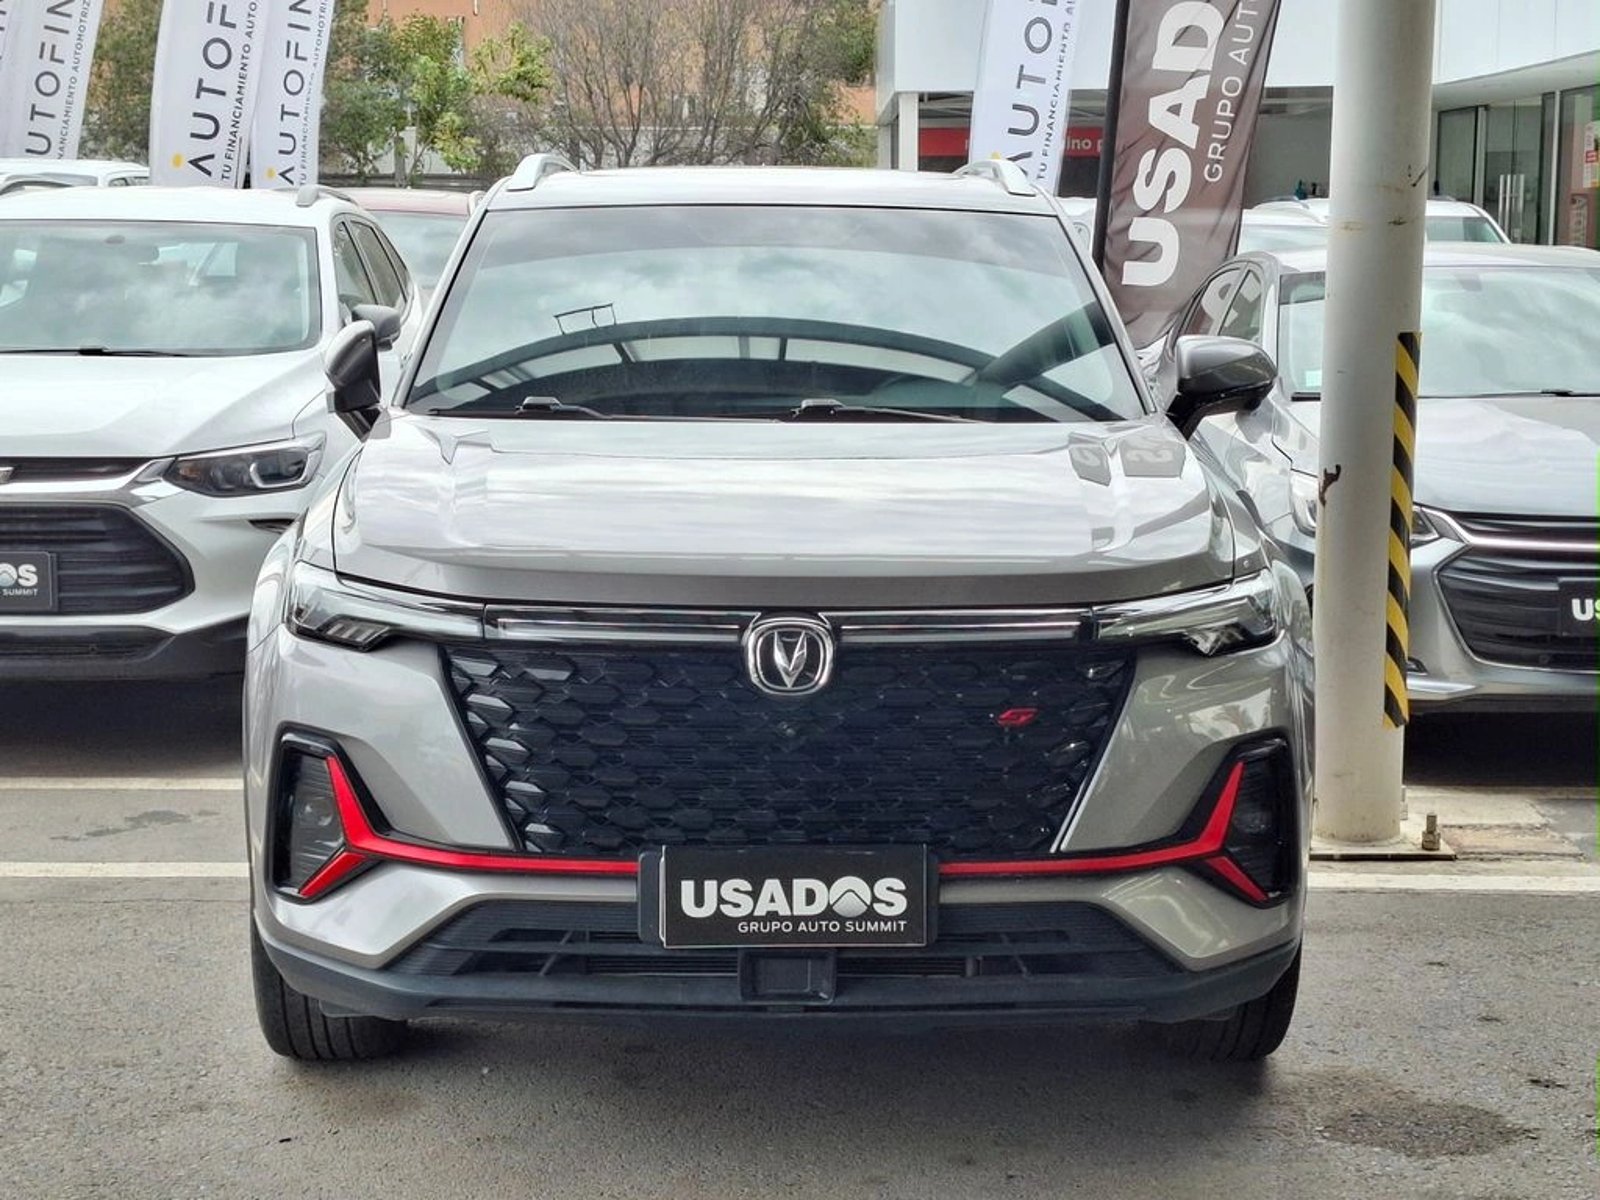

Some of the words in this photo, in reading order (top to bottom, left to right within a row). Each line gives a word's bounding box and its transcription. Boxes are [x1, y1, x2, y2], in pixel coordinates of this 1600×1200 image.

[225, 43, 251, 160] FINANCIAMIENTO
[1041, 22, 1071, 157] FINANCIAMIENTO
[1121, 1, 1225, 287] USAD
[1203, 75, 1243, 183] GRUPO
[221, 163, 232, 180] TU
[1036, 162, 1048, 180] TU
[680, 876, 908, 918] USADOS
[737, 920, 794, 934] GRUPO
[797, 920, 841, 933] AUTO
[845, 919, 908, 933] SUMMIT
